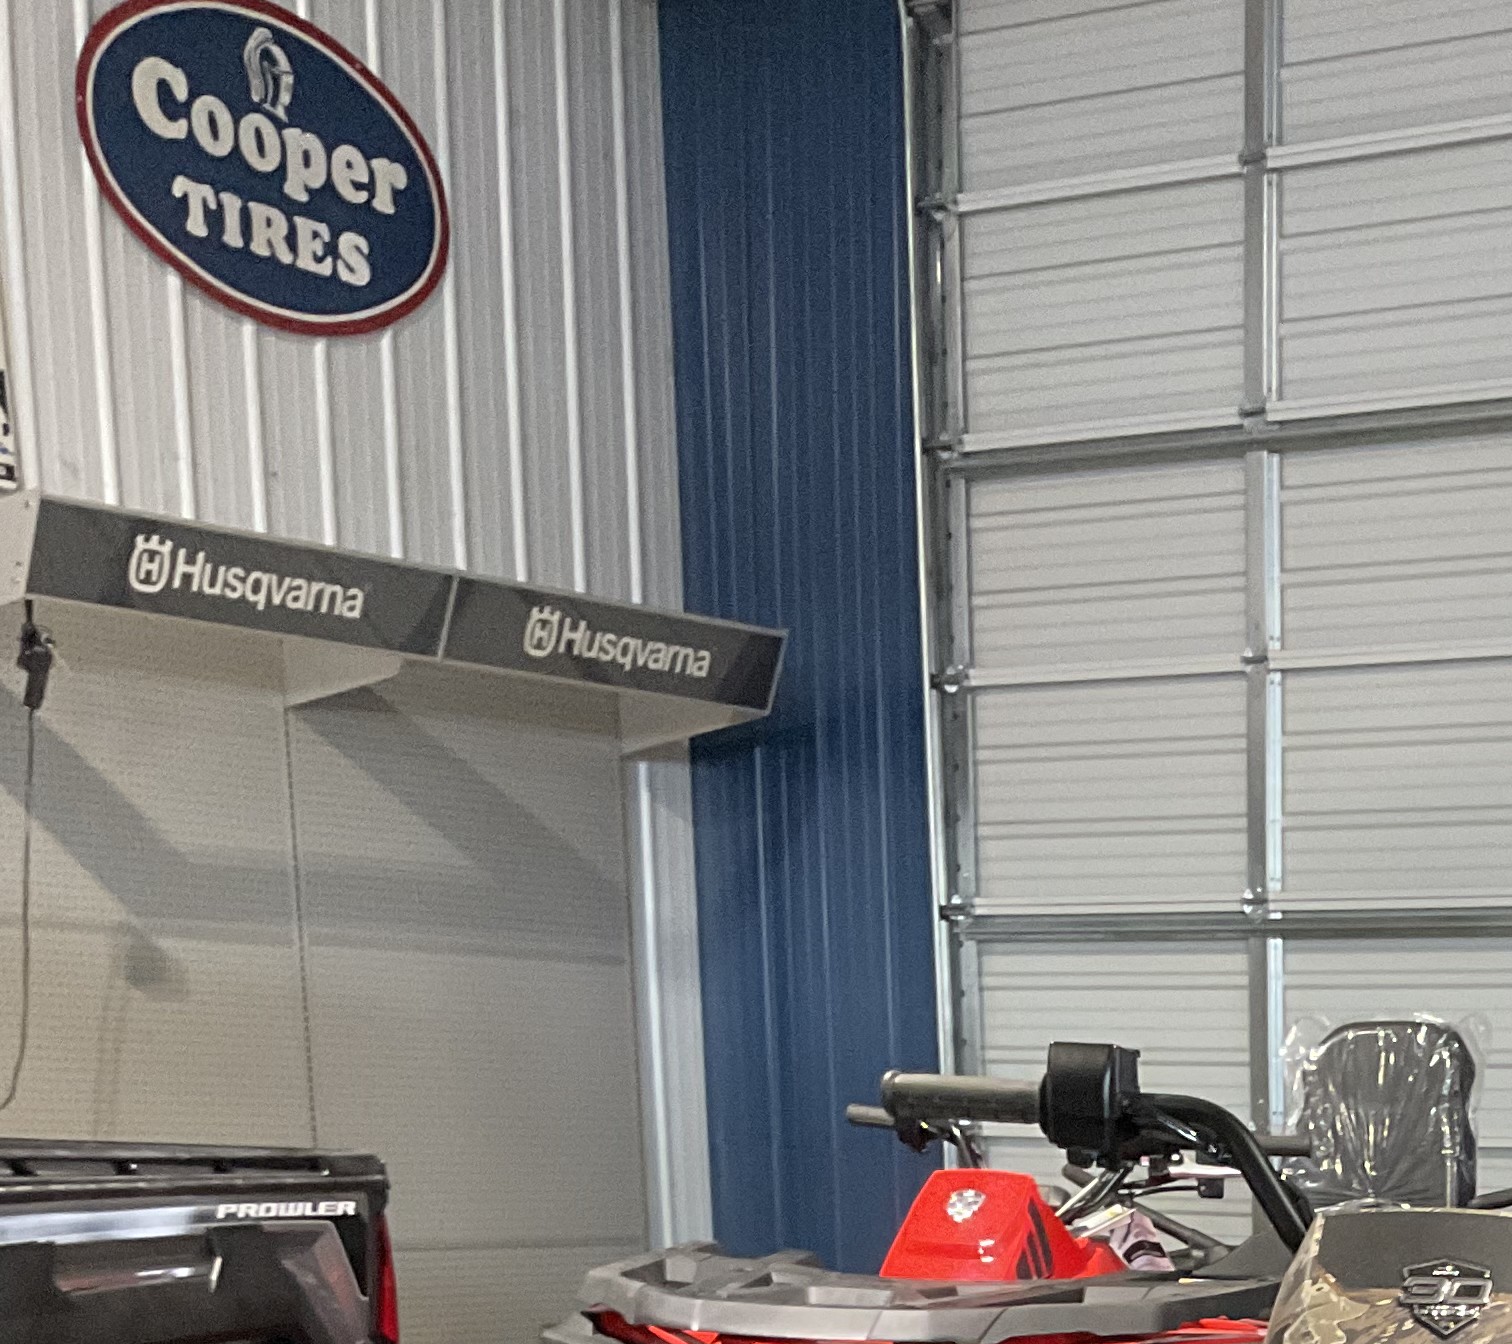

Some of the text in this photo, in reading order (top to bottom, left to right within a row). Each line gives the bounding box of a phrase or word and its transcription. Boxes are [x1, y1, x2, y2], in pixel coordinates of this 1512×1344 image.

[131, 56, 408, 215] Cooper
[171, 174, 372, 287] TIRES
[172, 548, 365, 619] Husqvarna
[558, 616, 712, 678] Husqvarna
[216, 1201, 356, 1219] PROWLER
